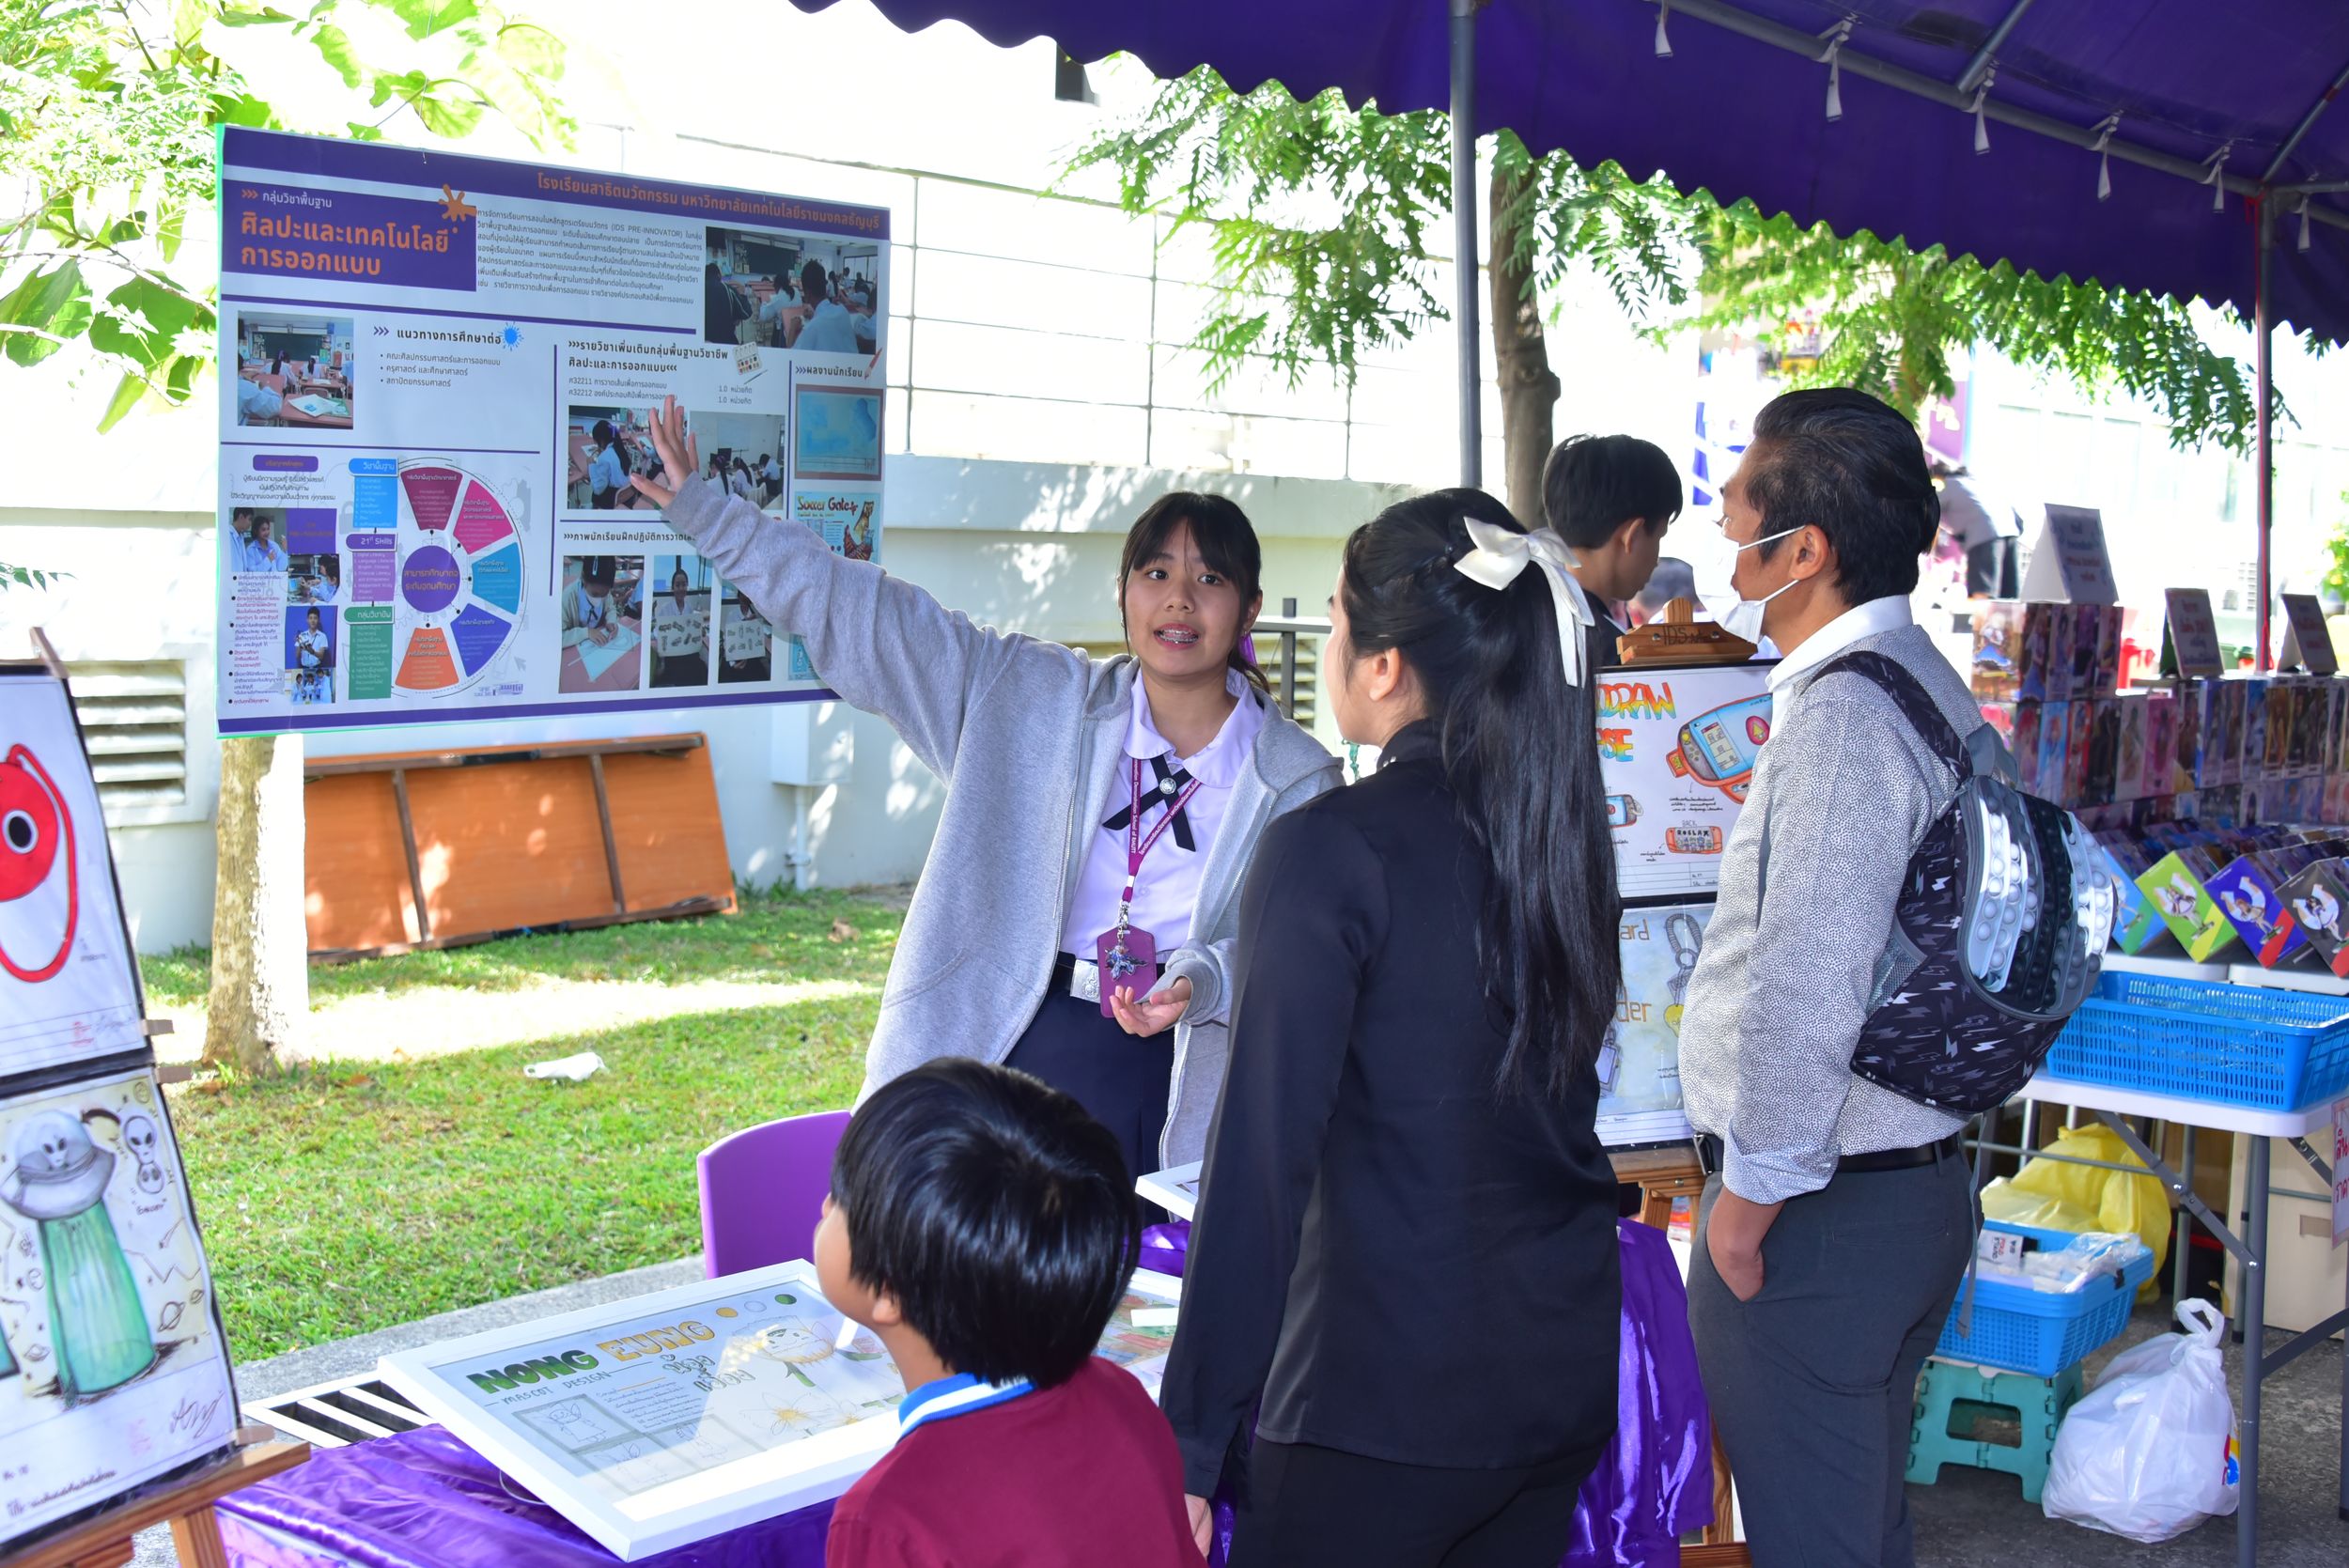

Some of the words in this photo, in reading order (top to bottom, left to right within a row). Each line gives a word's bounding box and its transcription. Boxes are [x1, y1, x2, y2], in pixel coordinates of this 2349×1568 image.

[262, 190, 333, 210] กลุ่มวิชาพื้นฐาน
[537, 172, 677, 206] โรงเรียนสาธิตนวัตกรรม
[681, 194, 880, 232] มหาวิทยาลัยเทคโนโลยีราชมงคลธัญบุรี
[241, 211, 449, 254] ศิลปะและเทคโนโลยี
[241, 246, 381, 275] การออกแบบ
[397, 328, 502, 345] แนวทางการศึกษาต่อ
[580, 340, 728, 360] รายวิชาเพิ่มเติมกลุ่มพื้นฐานวิชาชีพ
[568, 356, 666, 372] ศิลปะและการออกแบบ
[806, 365, 863, 378] ผลงานนักเรียน
[466, 1349, 599, 1394] NONG
[596, 1320, 715, 1362] EUNG
[501, 1386, 554, 1405] MASCOT
[564, 1371, 611, 1389] DESIGN
